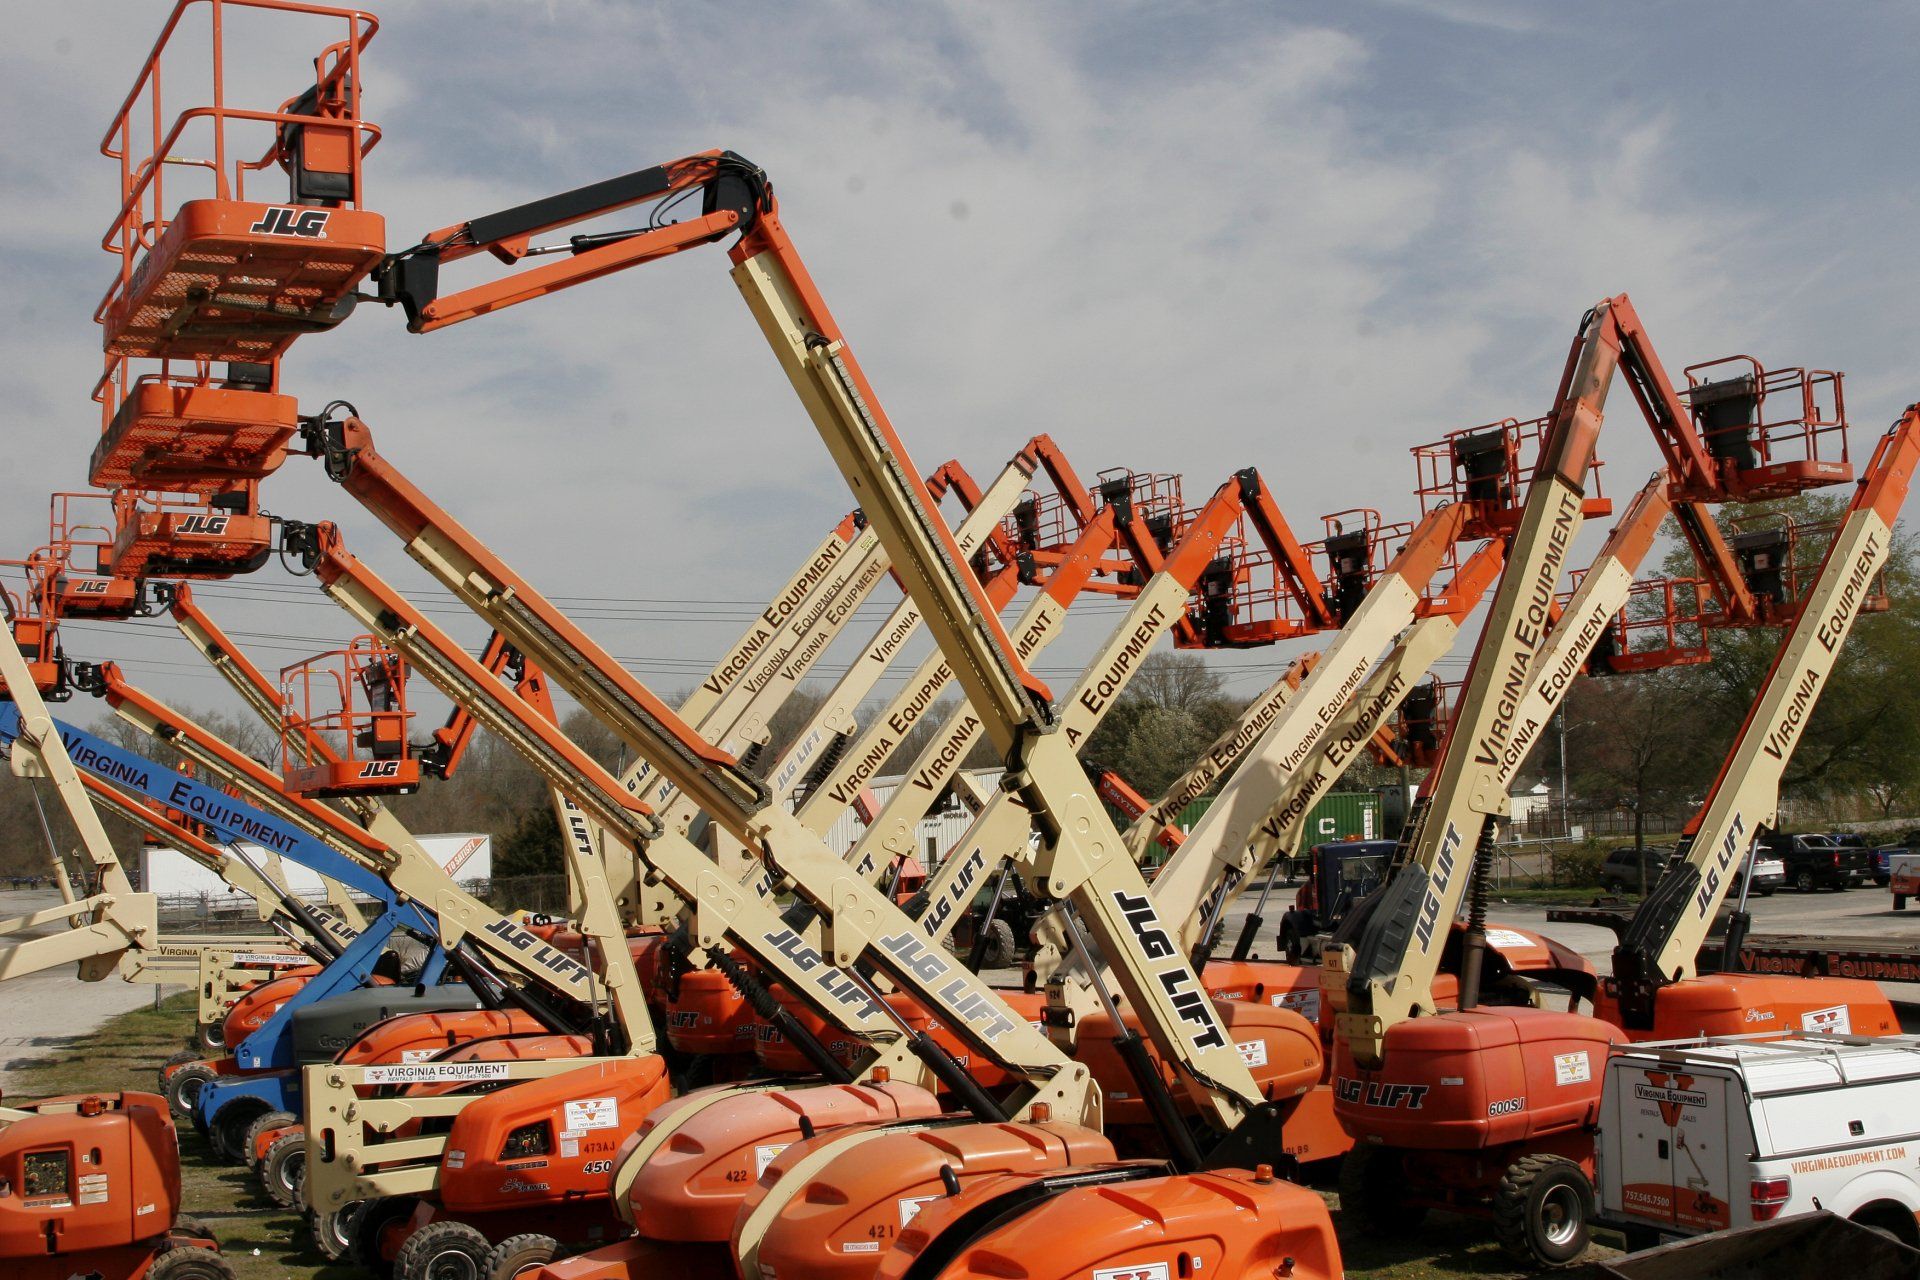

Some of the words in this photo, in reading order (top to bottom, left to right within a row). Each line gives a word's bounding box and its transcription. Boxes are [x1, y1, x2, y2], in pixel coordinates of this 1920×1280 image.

[250, 207, 329, 238] JLG
[176, 515, 229, 535] JLG
[75, 581, 109, 593] JLG
[703, 629, 771, 697] VIRGINIA
[762, 539, 843, 630] EQUIPMENT
[743, 646, 790, 695] VIRGINIA
[791, 575, 847, 637] EQUIPMENT
[781, 632, 829, 682] VIRGINIA
[825, 558, 882, 626] EQUIPMENT
[870, 609, 919, 665] VIRGINIA
[1474, 660, 1530, 768] VIRGINIA
[1514, 492, 1576, 650] EQUIPMENT
[1079, 602, 1166, 715] EQUIPMENT
[1764, 668, 1820, 761] VIRGINIA
[1816, 532, 1879, 654] EQUIPMENT
[1497, 717, 1539, 783] IRGINIA
[1537, 603, 1608, 706] EQUIPMENT
[828, 737, 893, 806] VIRGINIA
[888, 659, 951, 736] EQUIPME
[1280, 722, 1326, 775] VIRGINIA
[1317, 656, 1371, 725] EQUIPMENT
[358, 761, 401, 779] JLG
[636, 762, 651, 782] LIF
[776, 759, 798, 793] JLG
[796, 730, 822, 764] LIFT
[912, 715, 980, 792] VIRGINIA
[1150, 769, 1215, 830] VIRGINIA
[1211, 691, 1288, 768] EQUIPMENT
[1261, 771, 1328, 841] VIRGINIA
[1323, 671, 1406, 768] EQUIPMENT
[60, 732, 150, 790] VIRGINIA
[169, 782, 299, 854] EQUIPMENT
[1109, 788, 1142, 816] SKYTRA
[568, 816, 593, 856] LIFT
[1319, 818, 1335, 834] C
[949, 847, 985, 901] LIFT
[1695, 860, 1720, 921] JLG
[1714, 811, 1748, 876] LIFT
[1415, 892, 1440, 956] JLG
[1432, 819, 1463, 898] LIFT
[330, 919, 361, 940] LIF
[160, 946, 198, 956] VIRGINIA
[484, 919, 535, 951] JLG
[533, 946, 590, 986] LIFT
[1111, 890, 1179, 962] JLG
[1156, 966, 1227, 1050] LIFT
[1740, 950, 1818, 974] VIRGIN
[1827, 954, 1920, 979] EQUIPMEN
[763, 928, 822, 973] JLG
[816, 968, 883, 1022] LIFT
[879, 930, 949, 984] JLG
[936, 977, 1016, 1042] LIFT
[671, 1012, 700, 1028] LIFT
[758, 1025, 784, 1043] LIFT
[387, 1067, 436, 1077] VIRGINIA
[439, 1065, 507, 1076] EQUIPMENT
[1335, 1076, 1361, 1104] JLG
[1365, 1082, 1430, 1109] LIFT
[1488, 1097, 1525, 1116] 600SJ
[1637, 1086, 1666, 1100] VIRGINIA
[1667, 1090, 1705, 1104] EQUIPMENT
[583, 1160, 613, 1175] 450
[584, 1141, 615, 1154] 473AJ
[1791, 1147, 1906, 1174] VIRGINIAEQUIPMENT.COM
[726, 1170, 747, 1182] 422
[1625, 1190, 1670, 1207] 757.545.7500
[869, 1225, 894, 1238] 421
